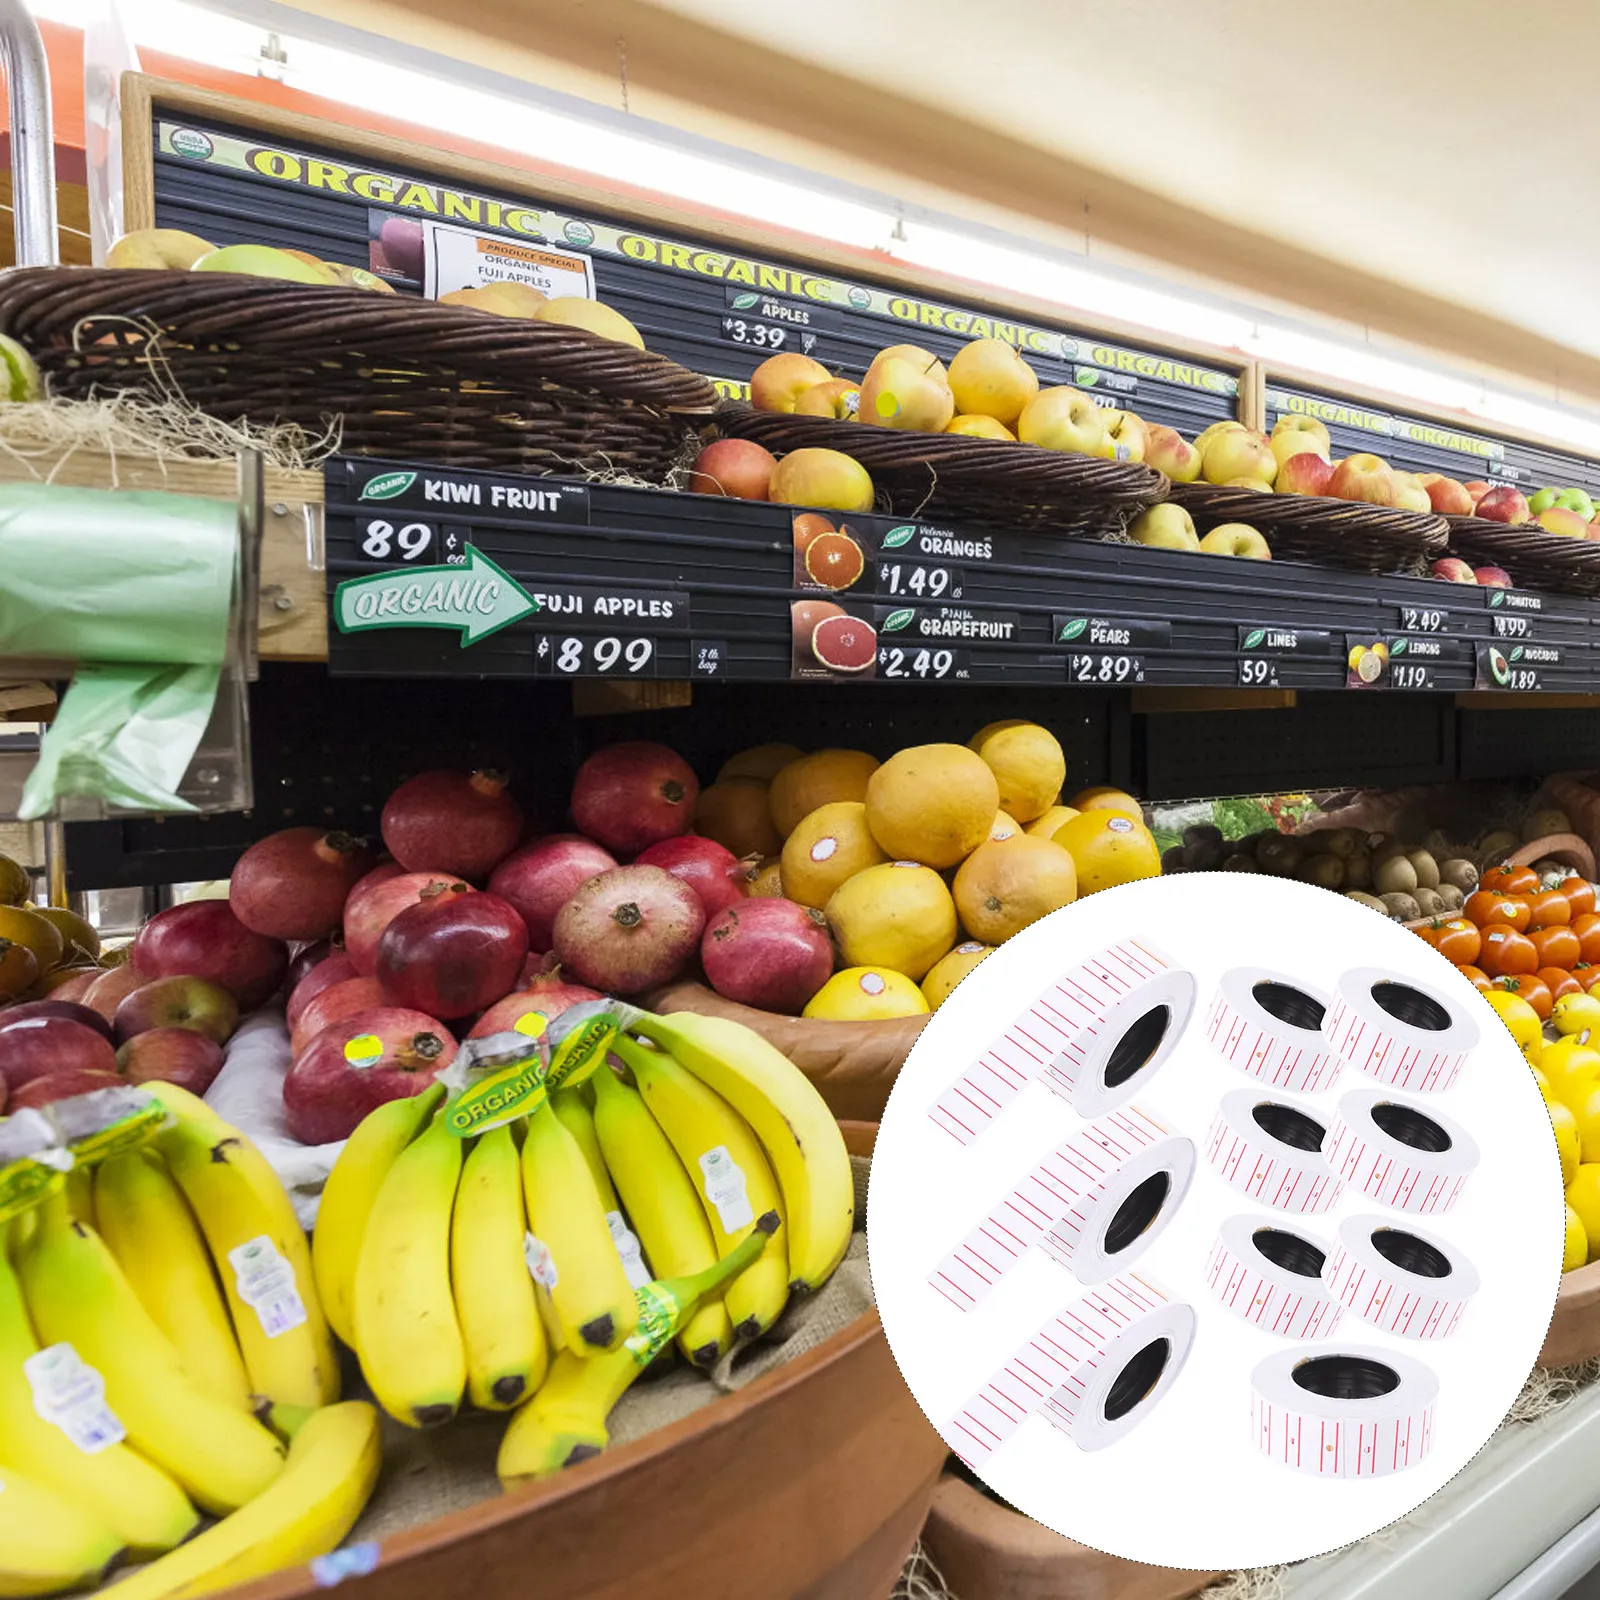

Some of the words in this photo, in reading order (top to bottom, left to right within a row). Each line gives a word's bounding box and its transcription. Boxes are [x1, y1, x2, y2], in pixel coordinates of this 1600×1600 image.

[245, 148, 542, 236] ORGANIC
[485, 243, 535, 261] PRODUCE
[536, 255, 577, 270] SPECIAL
[485, 254, 543, 273] ORGANIC
[617, 234, 831, 303] ORGANIC
[478, 266, 504, 280] FUJI
[507, 272, 552, 288] APPLES
[762, 303, 810, 324] APPLES
[888, 298, 1050, 353] ORGANIC
[724, 317, 786, 348] $3.39
[1092, 346, 1217, 390] ORGANIC
[1289, 396, 1387, 433] ORGANIC
[1409, 425, 1489, 457] ORGANIC
[368, 475, 406, 495] ORGANIC
[424, 479, 481, 505] KIWI
[490, 486, 562, 511] FRUIT
[362, 519, 431, 560] 89
[920, 537, 992, 559] ORANGES
[880, 563, 949, 597] $1.49
[354, 579, 501, 619] ORGANIC
[534, 593, 583, 614] FUJI
[594, 596, 674, 618] APPLES
[920, 618, 1014, 639] GRAPEFRUIT
[1404, 609, 1440, 632] $2.49
[1090, 629, 1131, 645] PEARS
[1408, 642, 1441, 656] LEMONS
[879, 647, 953, 679] $2.49
[1073, 655, 1131, 682] $2.89
[1241, 659, 1268, 684] 59
[453, 1064, 544, 1128] ORGANIC
